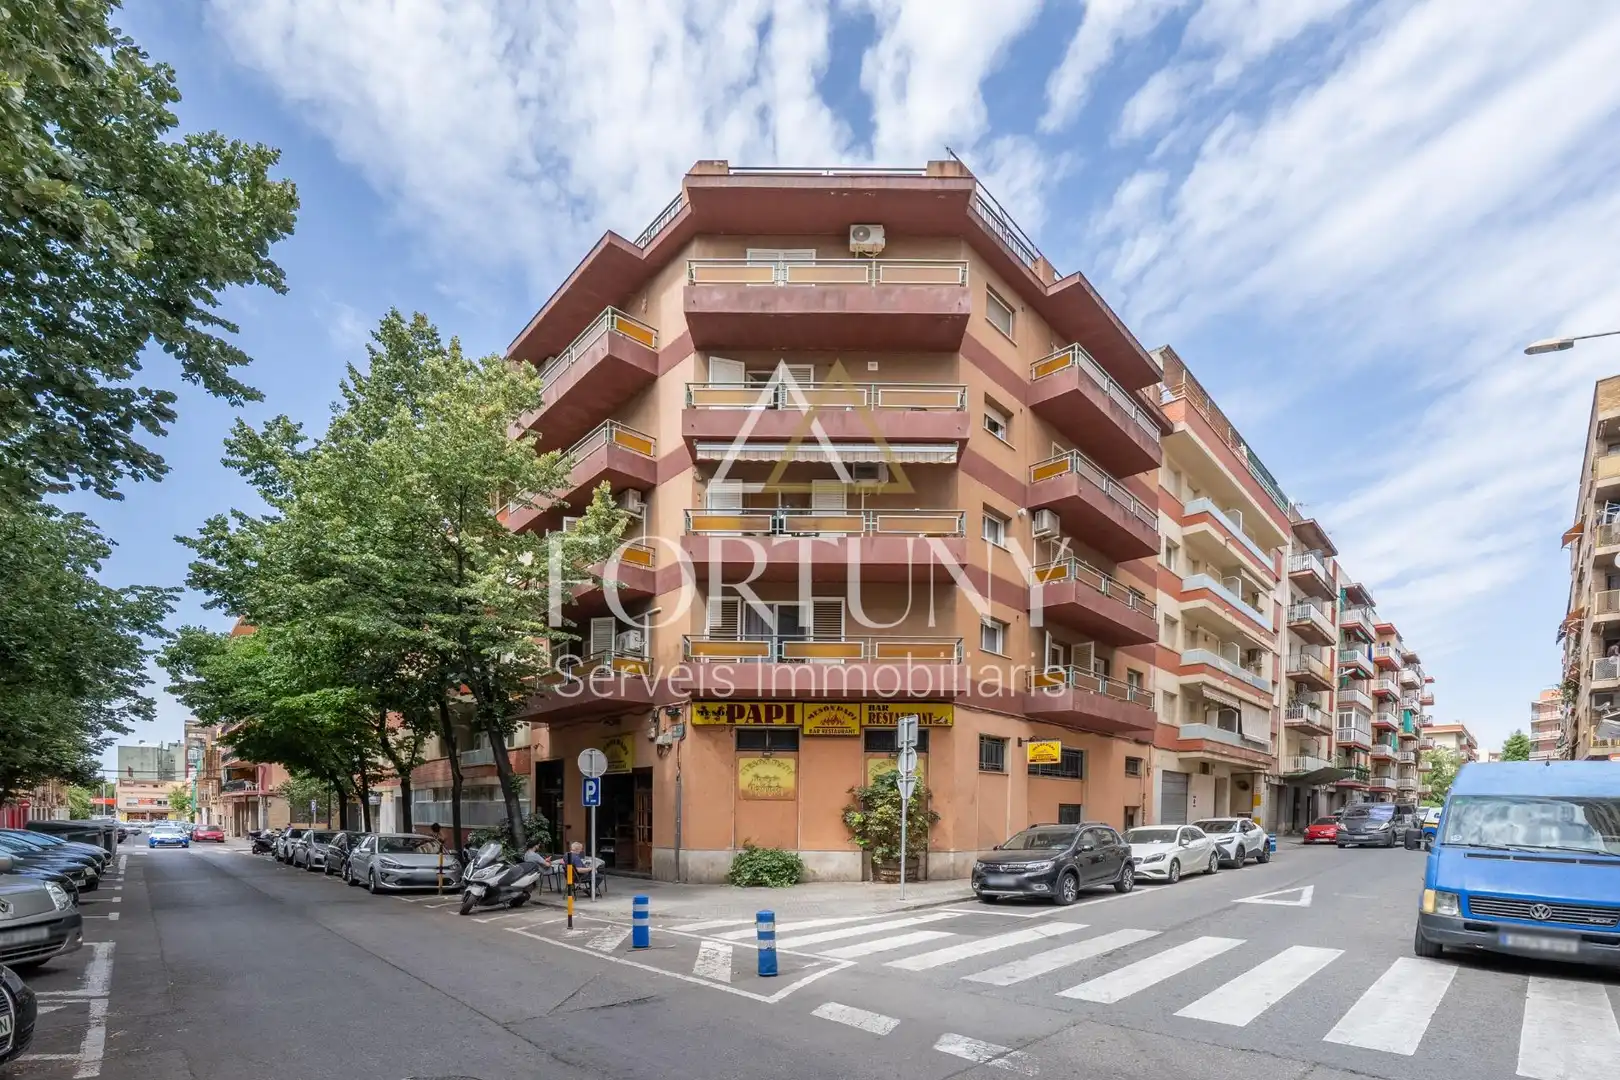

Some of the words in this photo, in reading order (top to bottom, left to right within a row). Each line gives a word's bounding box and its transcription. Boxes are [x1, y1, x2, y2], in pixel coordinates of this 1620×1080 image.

[726, 704, 796, 723] PAPI
[868, 704, 889, 712] BAR
[586, 781, 596, 803] P
